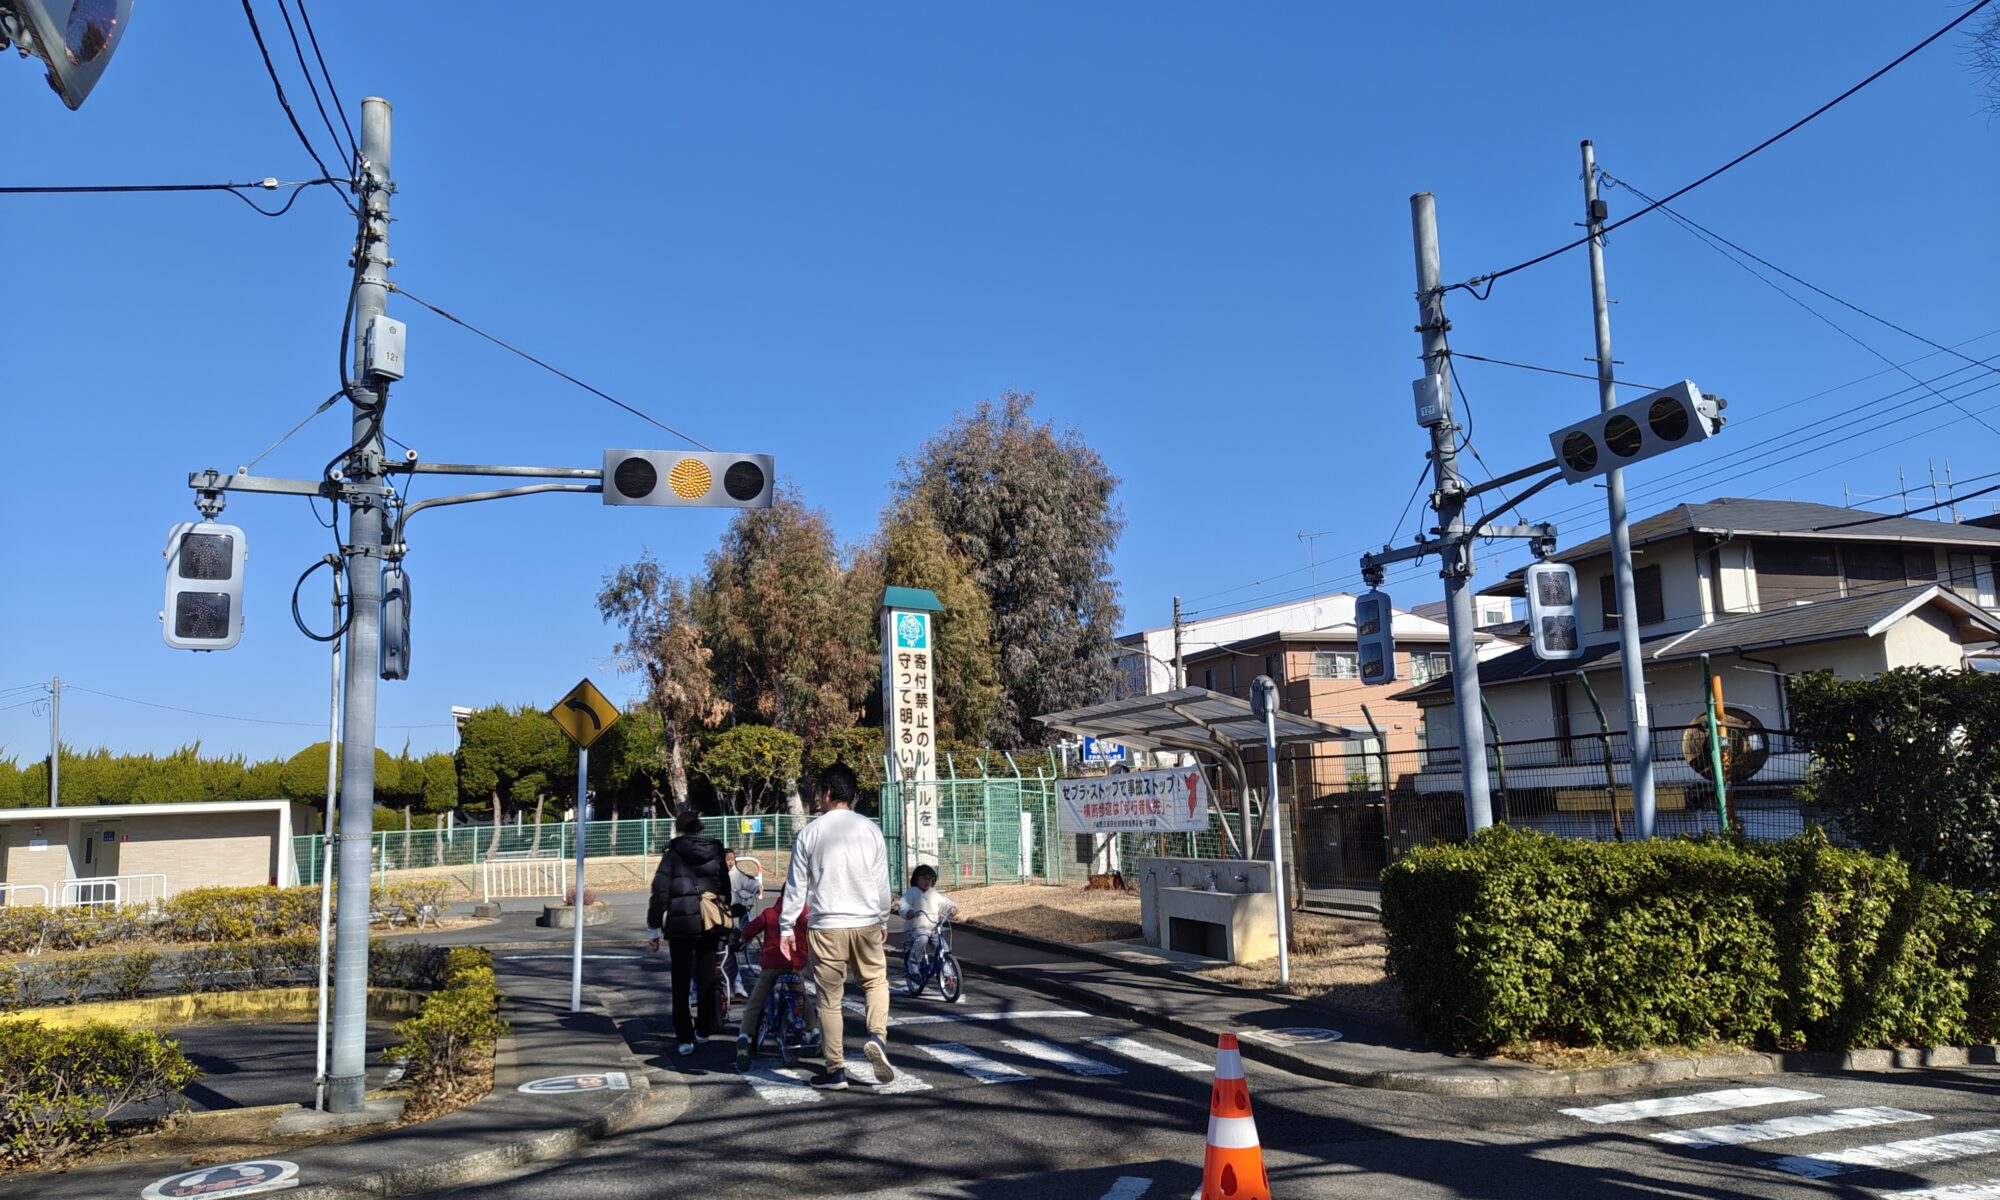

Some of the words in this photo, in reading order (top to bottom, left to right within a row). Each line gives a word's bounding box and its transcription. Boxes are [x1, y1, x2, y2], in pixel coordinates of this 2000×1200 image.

[914, 653, 932, 827] 寄付禁止のルールを
